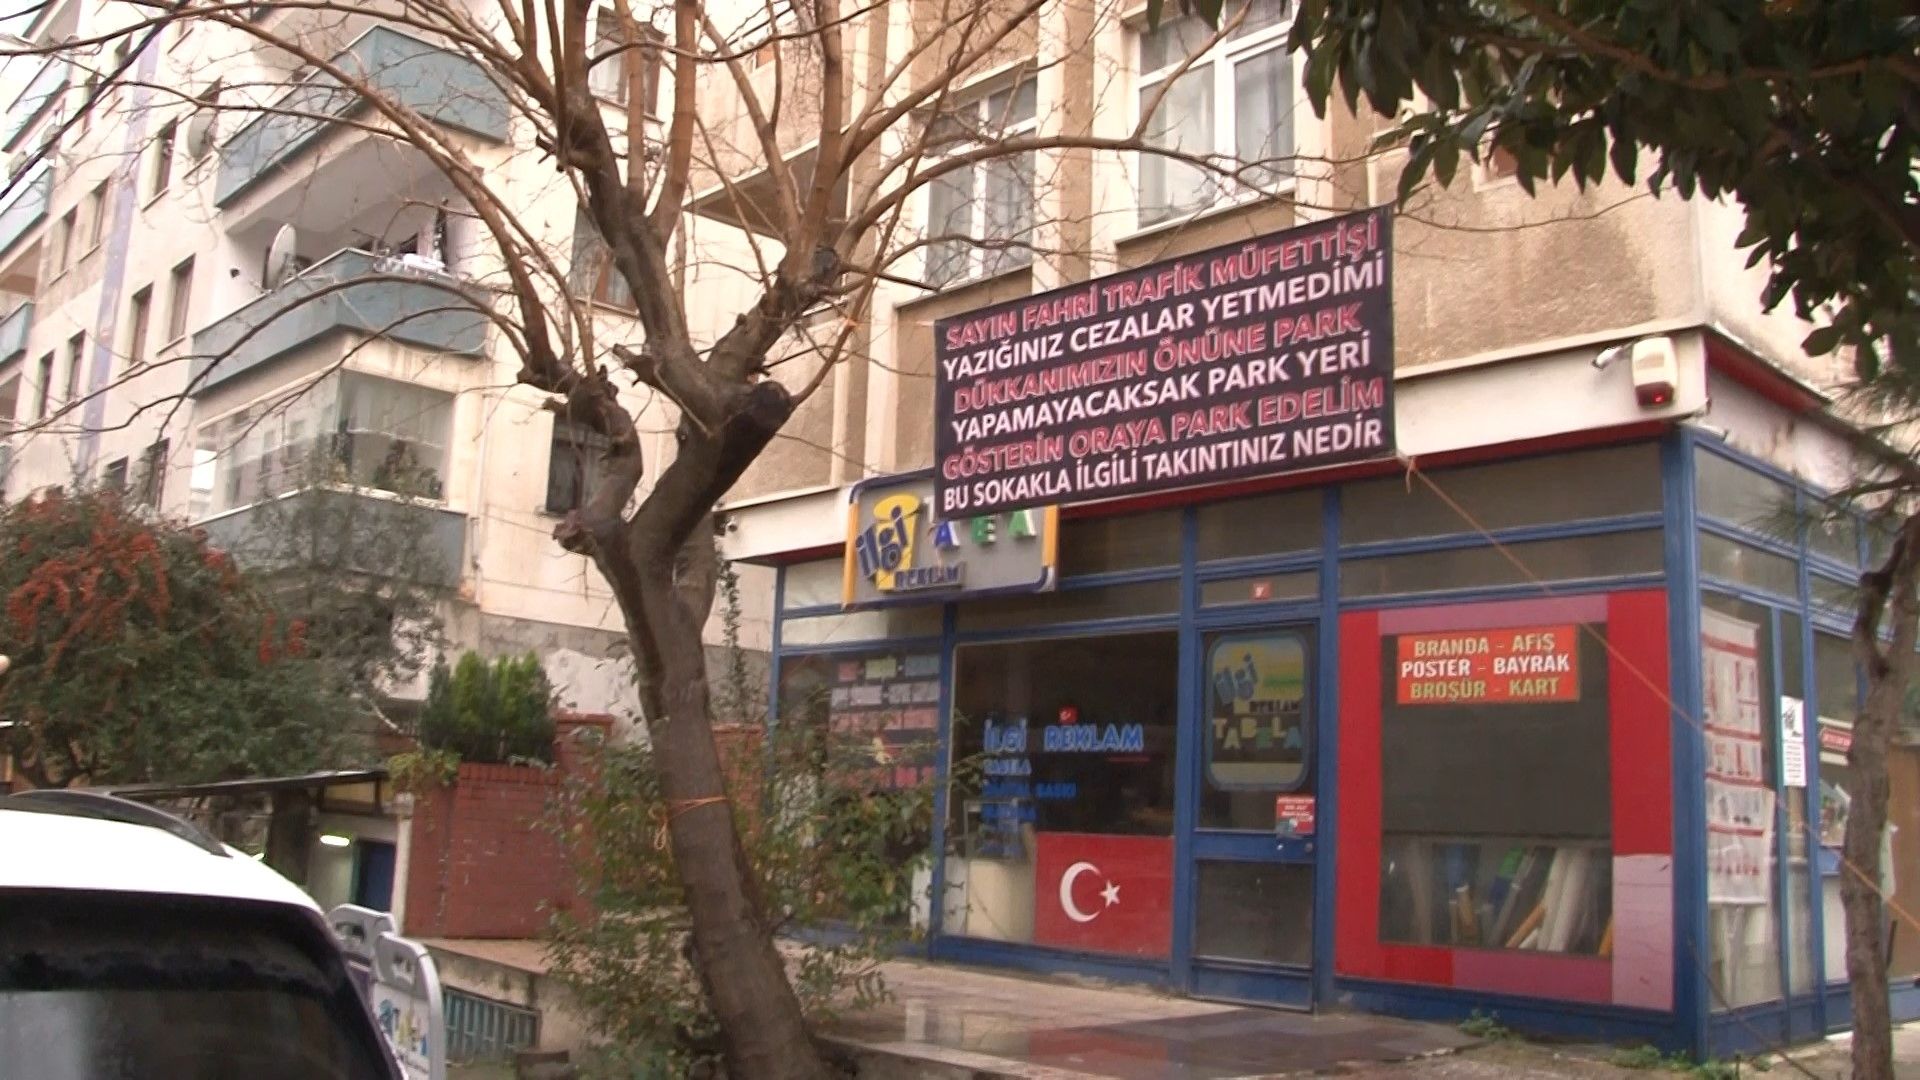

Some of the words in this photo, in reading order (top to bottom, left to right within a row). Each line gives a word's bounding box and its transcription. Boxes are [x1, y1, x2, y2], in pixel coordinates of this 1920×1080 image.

[943, 333, 1064, 381] YAZIĞINIZ
[1070, 303, 1195, 352] CEZALAR
[1202, 251, 1384, 322] YETMEDİMİ
[946, 311, 1017, 350] SAYIN
[1022, 284, 1098, 332] FAHRİ
[1103, 262, 1204, 312] TRAFİK
[1210, 214, 1379, 289] MÜFETTİŞİ
[952, 371, 1201, 442] YAPAMAYACAKSAK
[1208, 353, 1290, 395] PARK
[1297, 331, 1370, 378] YERİ
[954, 349, 1148, 414] DÜKKANIMIZIN
[1154, 323, 1266, 371] ÖNÜNE
[1274, 301, 1363, 348] PARK
[943, 431, 1064, 480] GÖSTERİN
[1069, 416, 1166, 458] ORAYA
[1171, 401, 1253, 441] PARK
[1258, 375, 1384, 427] EDELİM
[944, 484, 968, 512] BU
[973, 468, 1072, 507] SOKAKLA
[1076, 450, 1137, 491] İLGİLİ
[1143, 432, 1286, 480] TAKINTINIZ
[1293, 414, 1382, 458] NEDİR
[1401, 658, 1471, 678] POSTER
[1493, 653, 1570, 675] BAYRAK
[1414, 638, 1489, 657] BRANDA
[1509, 677, 1559, 696] KART
[1043, 724, 1144, 752] REKLAM
[1212, 717, 1303, 750] TABELA
